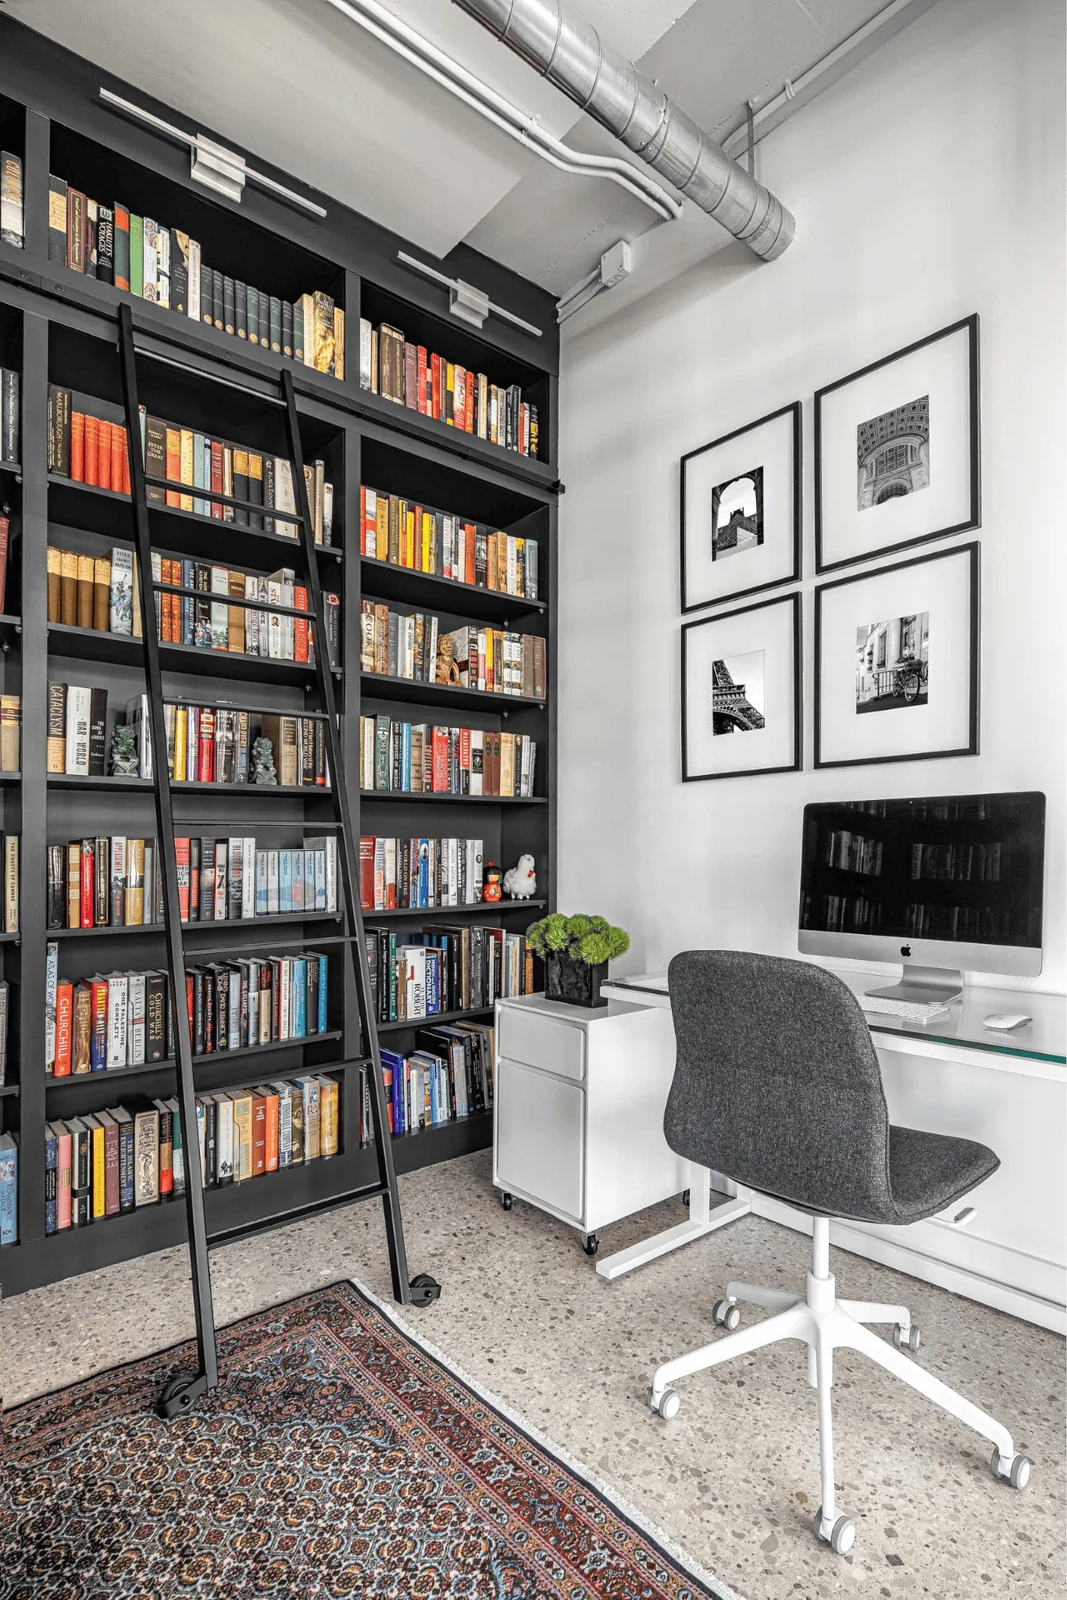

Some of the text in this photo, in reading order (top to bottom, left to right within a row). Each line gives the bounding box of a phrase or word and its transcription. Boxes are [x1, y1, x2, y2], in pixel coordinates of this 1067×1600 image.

[6, 159, 20, 205] COLLAPSE
[50, 686, 64, 735] CATACLYSM
[76, 721, 87, 767] WAR WORLD
[115, 842, 123, 874] APPEASEMENT
[403, 872, 408, 881] ON
[47, 979, 55, 988] OF
[413, 983, 422, 1016] ROBERT
[46, 991, 55, 1015] WORLD
[154, 992, 164, 1040] CHURCHILL'S
[46, 1016, 54, 1030] WAR
[58, 998, 70, 1060] CHURCHILL
